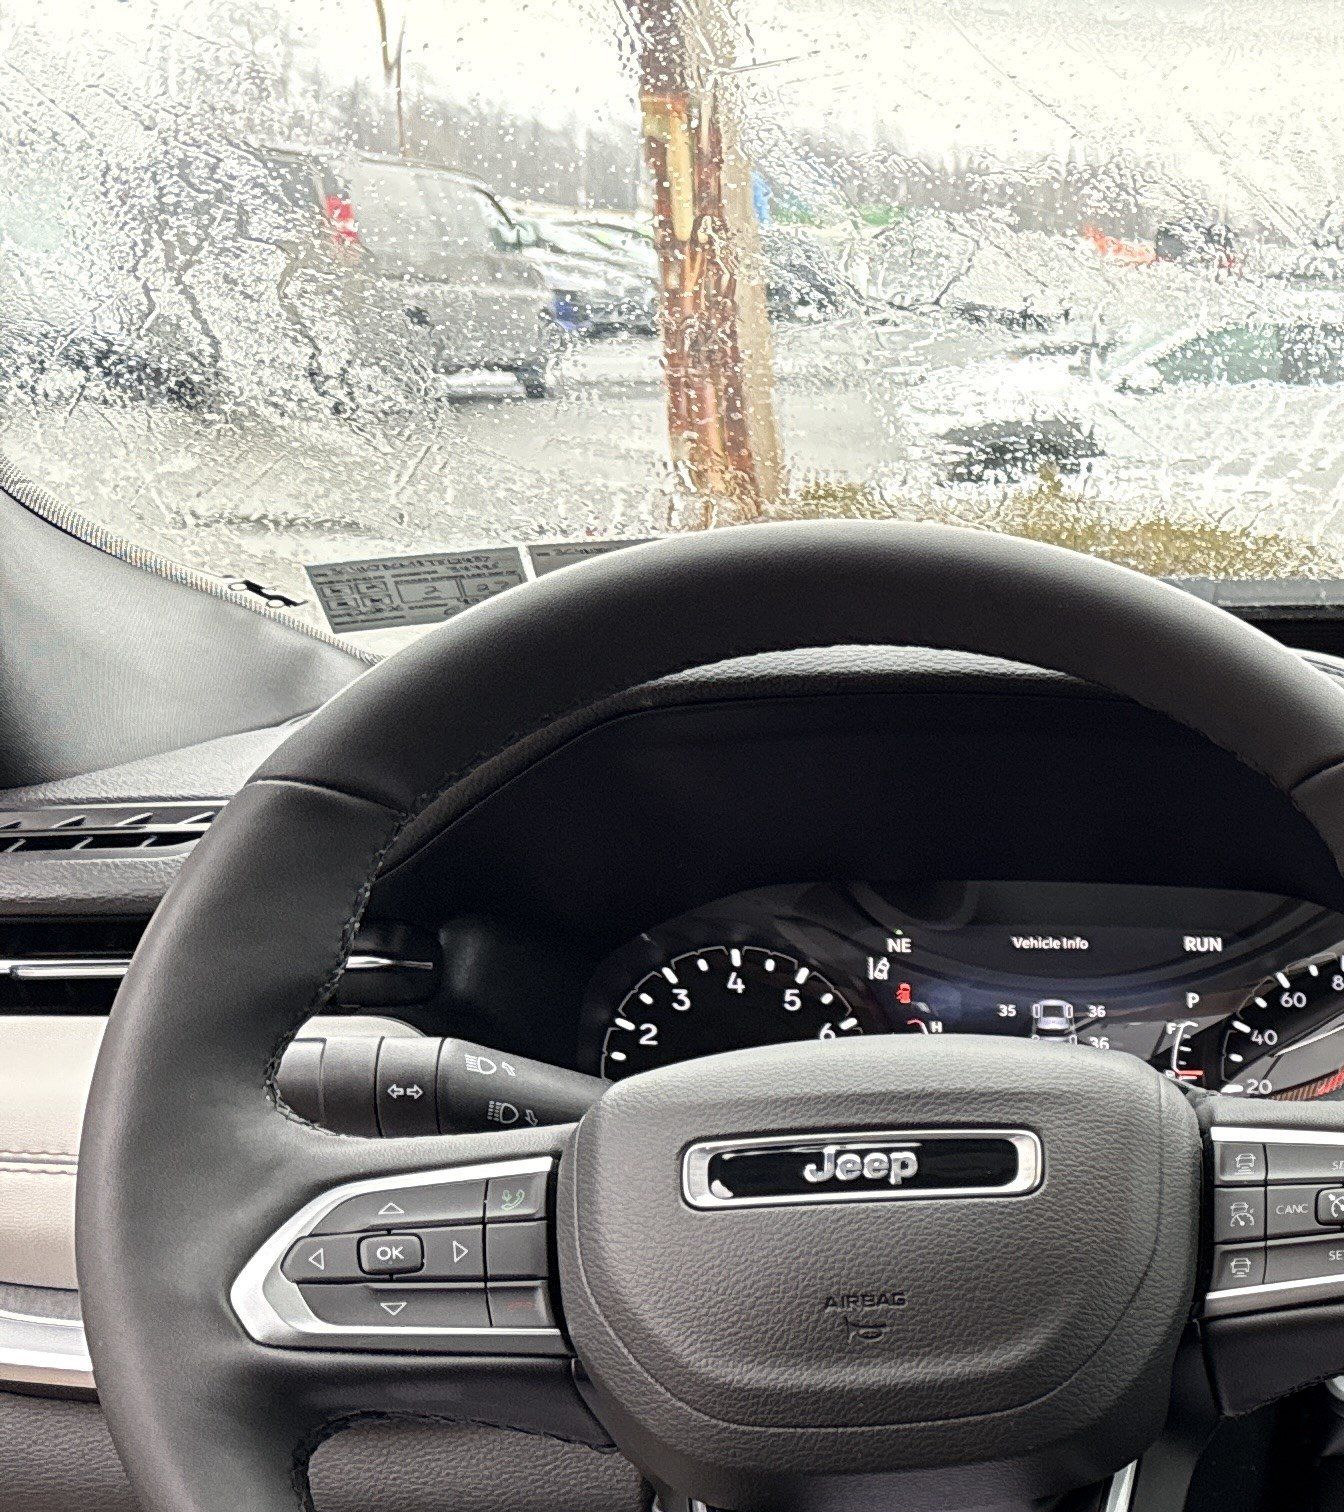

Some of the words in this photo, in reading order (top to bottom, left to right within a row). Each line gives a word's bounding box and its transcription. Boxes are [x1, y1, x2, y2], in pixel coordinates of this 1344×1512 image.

[886, 938, 911, 953] NE
[1011, 936, 1061, 950] Vehicle
[1062, 936, 1089, 951] Info
[1183, 937, 1222, 951] RUN
[726, 971, 746, 994] 4
[671, 988, 691, 1011] 3
[783, 988, 801, 1011] 5
[1186, 992, 1200, 1008] P
[1279, 992, 1307, 1008] 60
[998, 1004, 1017, 1018] 35
[1088, 1004, 1106, 1018] 36
[638, 1023, 659, 1046] 2
[819, 1022, 836, 1040] 6
[930, 1021, 943, 1034] H
[1251, 1029, 1278, 1046] 40
[1246, 1079, 1273, 1095] 20
[803, 1145, 919, 1185] Jeep
[1275, 1203, 1309, 1215] CANC
[376, 1245, 404, 1261] OK
[824, 1291, 908, 1310] AIRBAG
